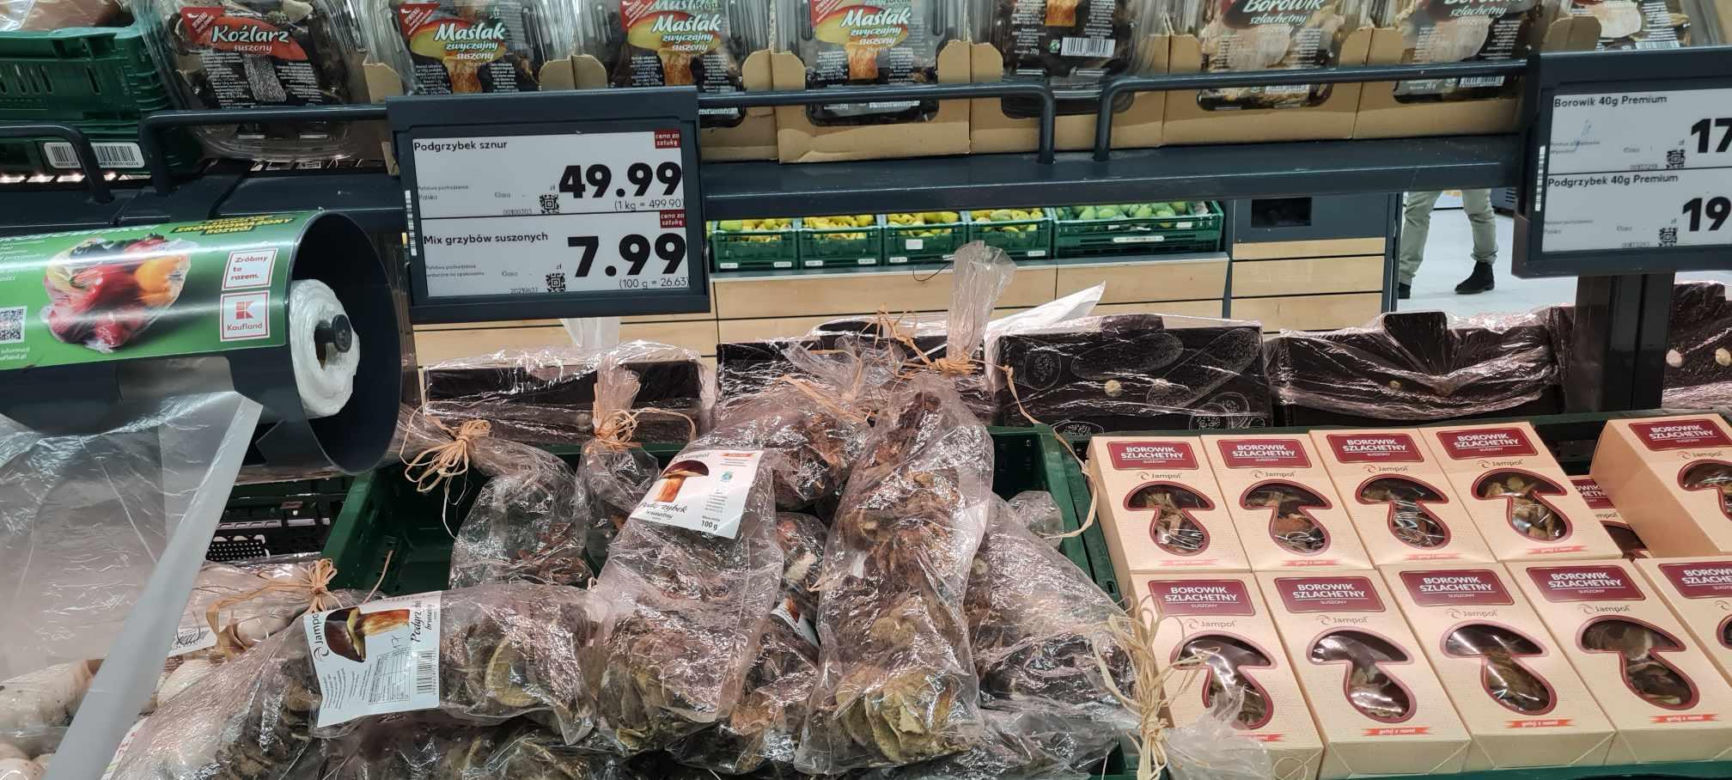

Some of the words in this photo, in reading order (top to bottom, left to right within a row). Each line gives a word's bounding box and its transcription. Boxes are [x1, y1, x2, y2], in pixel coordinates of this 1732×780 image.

[1449, 7, 1507, 17] szlachetny
[841, 8, 911, 27] Maślak
[1249, 12, 1306, 24] szlachetny
[652, 13, 721, 32] Maślak
[212, 24, 289, 43] Koźlarz
[434, 22, 506, 41] Maślak
[851, 27, 902, 36] zwyczajny
[662, 33, 713, 42] zwyczajny
[234, 44, 273, 53] suszony
[446, 42, 498, 52] zwyczajny
[672, 43, 707, 52] suszony
[456, 52, 494, 61] suszony
[1554, 96, 1595, 107] Borowik
[1599, 96, 1618, 107] 40g
[1621, 95, 1667, 105] Premium
[1690, 117, 1732, 154] 17
[414, 140, 476, 153] Podgrzybek
[480, 141, 508, 149] sznur
[559, 161, 683, 199] 49.99
[1547, 174, 1608, 188] Podgrzybek
[1611, 175, 1631, 186] 40g
[1633, 173, 1678, 183] Premium
[614, 200, 623, 211] (1
[625, 201, 636, 212] kg
[1682, 196, 1732, 232] 19
[423, 235, 442, 245] Mix
[446, 234, 491, 246] grzybów
[495, 232, 549, 244] suszonych
[567, 232, 687, 278] 7.99
[619, 279, 640, 289] (100
[226, 322, 263, 331] Kaufland
[1650, 424, 1703, 432] BOROWIK
[1457, 433, 1509, 441] BOROWIK
[1648, 430, 1714, 439] SZLACHETNY
[1347, 438, 1397, 446] BOROWIK
[1454, 439, 1519, 448] SZLACHETNY
[1342, 444, 1406, 452] SZLACHETNY
[701, 519, 713, 528] 100
[1423, 576, 1481, 584] BOROWIK
[1551, 572, 1610, 580] BOROWIK
[1297, 583, 1354, 591] BOROWIK
[1419, 583, 1492, 592] SZLACHETNY
[1548, 579, 1622, 588] SZLACHETNY
[1170, 586, 1228, 594] BOROWIK
[1292, 590, 1366, 598] SZLACHETNY
[1164, 594, 1238, 602] SZLACHETNY
[311, 613, 324, 645] Jampo
